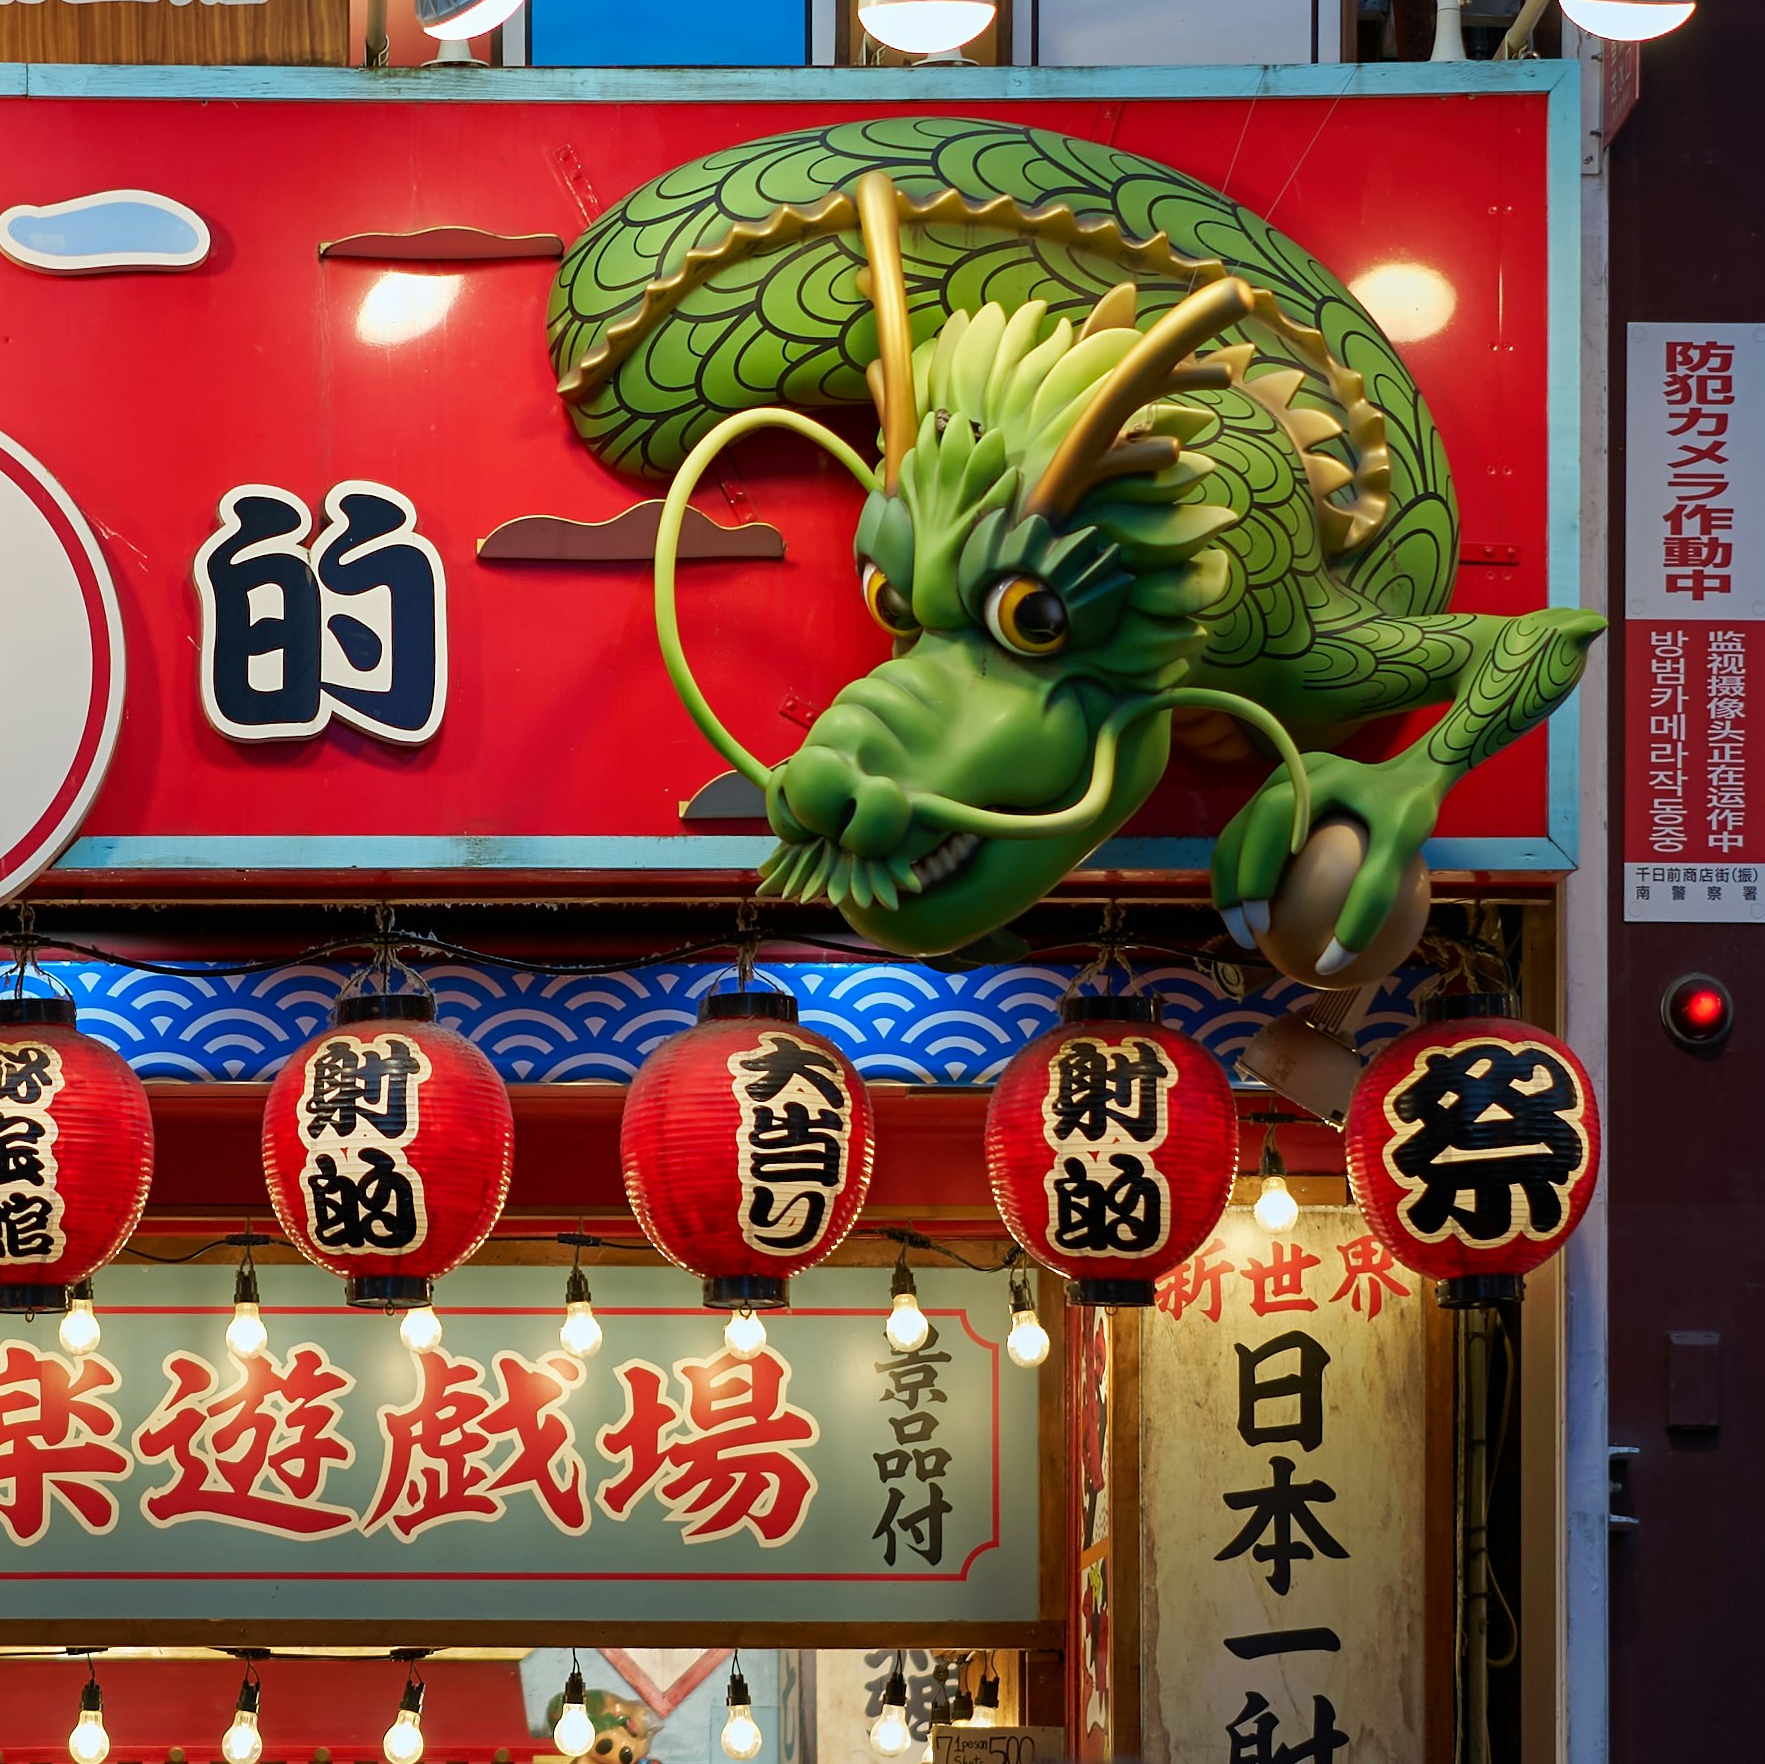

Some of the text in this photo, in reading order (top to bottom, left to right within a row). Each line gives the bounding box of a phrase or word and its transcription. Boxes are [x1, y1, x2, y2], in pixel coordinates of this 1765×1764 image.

[1662, 341, 1736, 602] 防犯カメラ作動中
[1648, 630, 1689, 853] 방범카메라작동중
[1706, 630, 1746, 853] 监视摄像头正在运作中
[1635, 868, 1758, 884] 千日前商店街(振)
[1635, 885, 1758, 901] 南警察署
[306, 1036, 417, 1253] 射的
[744, 1032, 847, 1254] 大当り
[1055, 1036, 1172, 1254] 射的
[1386, 1047, 1585, 1239] 祭
[1153, 1235, 1412, 1322] 新世界
[872, 1327, 953, 1567] 景品付
